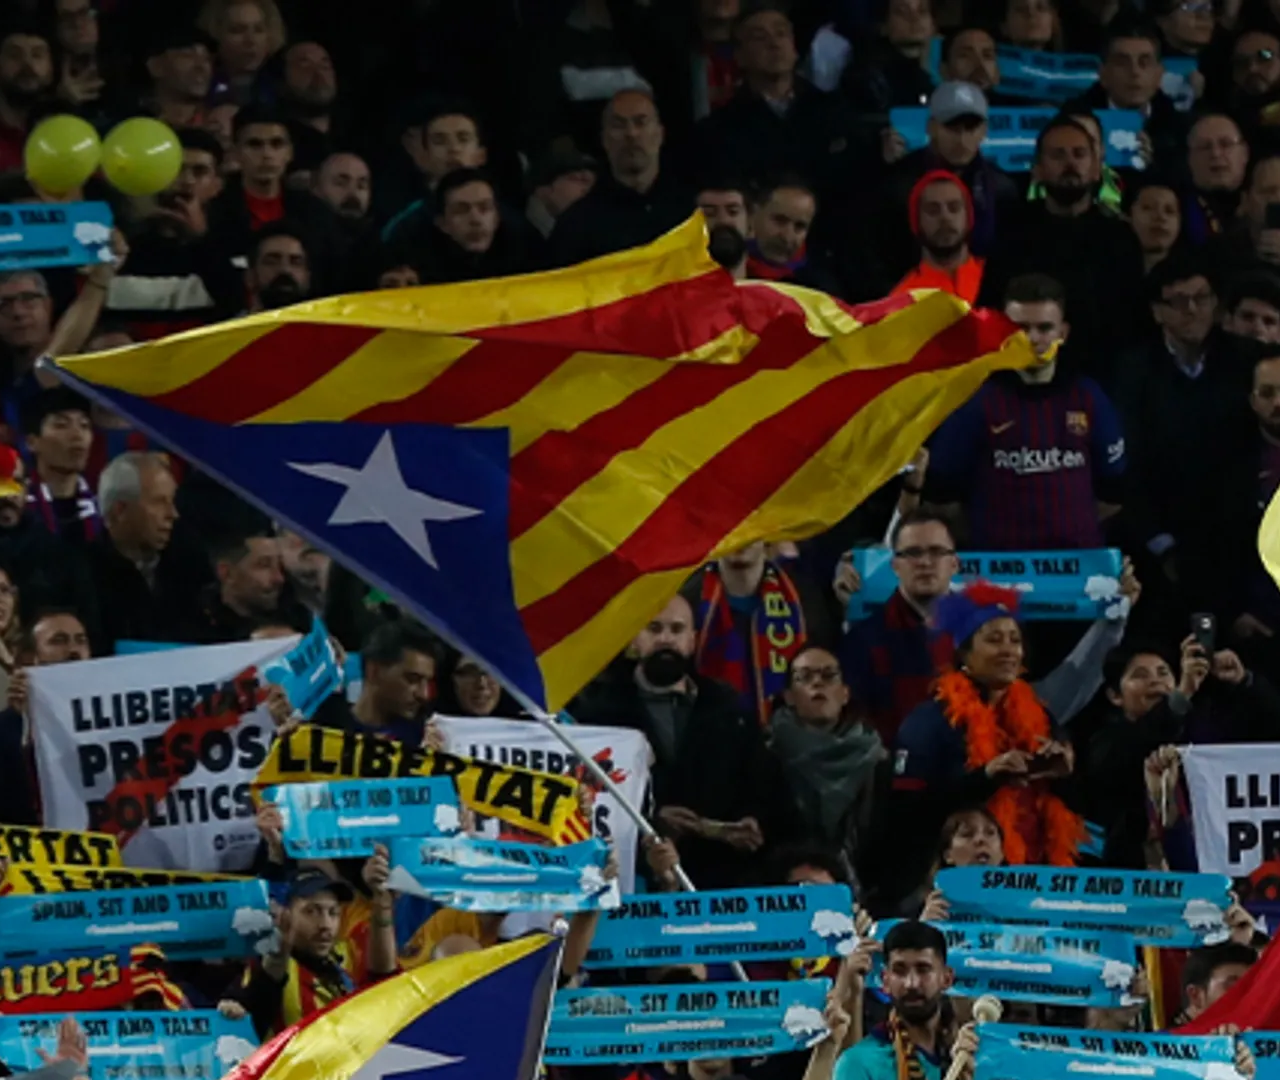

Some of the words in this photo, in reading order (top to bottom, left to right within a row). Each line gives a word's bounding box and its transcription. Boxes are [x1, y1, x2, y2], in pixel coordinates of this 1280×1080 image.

[72, 678, 261, 732] LLIBERTAT
[77, 725, 267, 788] PRESOS
[277, 727, 573, 827] LLIBERTAT
[86, 783, 258, 834] POLITICS
[982, 870, 1042, 893] SPAIN,
[1050, 874, 1078, 894] SIT
[1084, 876, 1125, 895] AND
[1132, 878, 1184, 899] TALK!
[32, 900, 90, 922] SPAIN,
[98, 897, 124, 917] SIT
[132, 895, 169, 915] AND
[178, 891, 228, 912] TALK!
[607, 901, 669, 921] SPAIN,
[676, 898, 701, 917] SIT
[710, 896, 749, 915] AND
[758, 894, 807, 913] TALK!
[568, 997, 633, 1017] SPAIN,
[640, 993, 668, 1012] SIT
[676, 991, 718, 1011] AND
[725, 989, 780, 1009] TALK!
